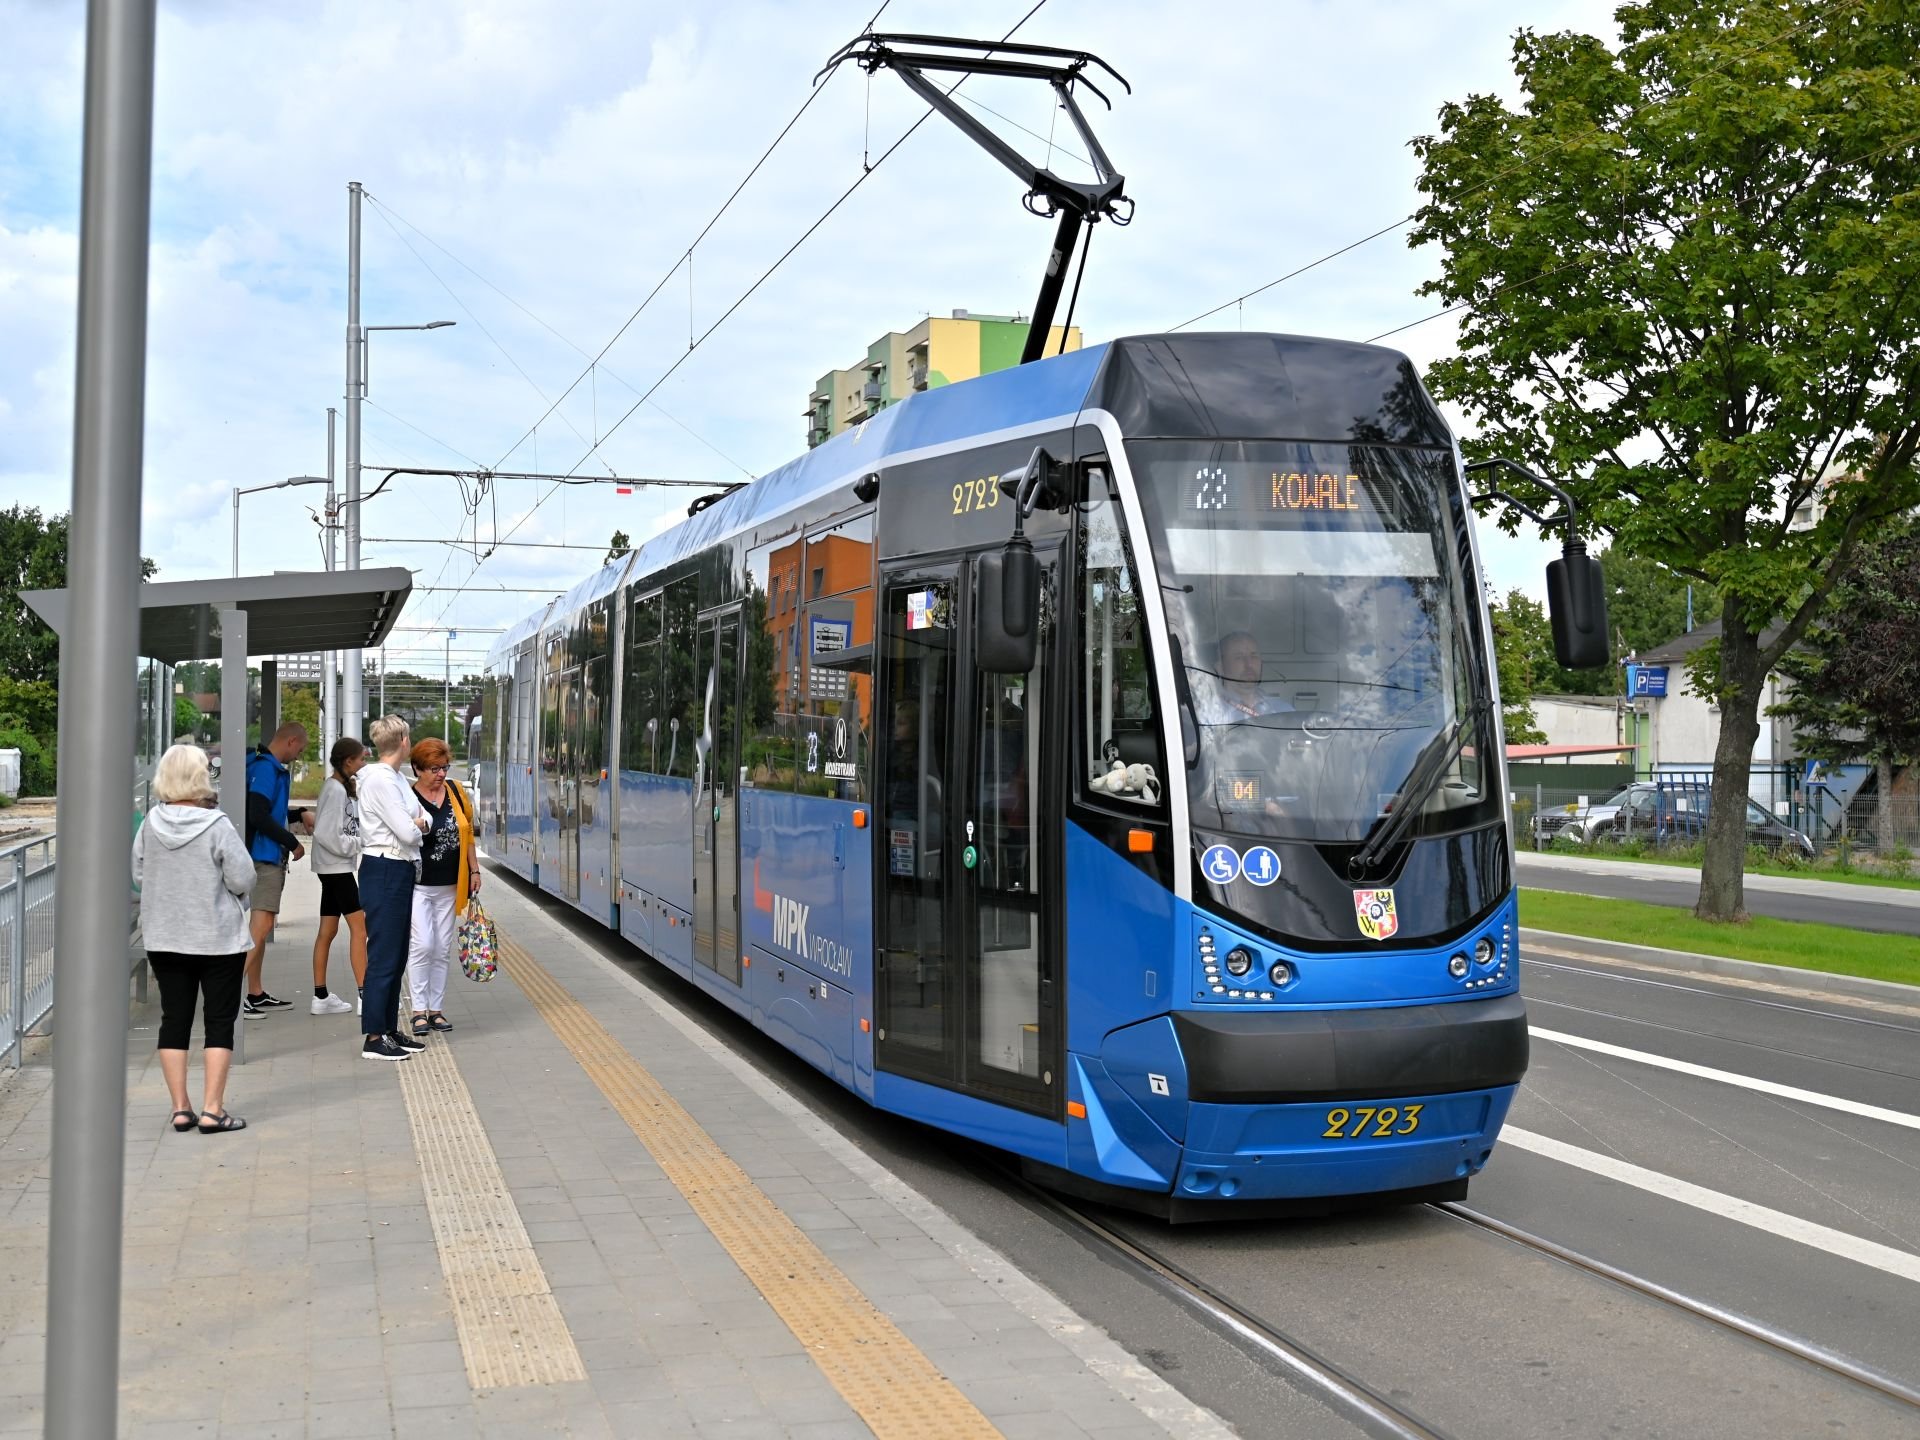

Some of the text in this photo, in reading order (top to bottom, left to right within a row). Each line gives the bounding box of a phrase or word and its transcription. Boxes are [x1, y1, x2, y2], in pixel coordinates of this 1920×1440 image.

[952, 475, 999, 515] 2723
[1272, 473, 1359, 509] KOWALE
[1637, 676, 1646, 688] P
[824, 761, 856, 777] MODERTRANS
[1234, 781, 1253, 799] 04
[773, 893, 853, 978] MPK WROCŁAW
[1360, 915, 1377, 934] W
[1321, 1104, 1424, 1138] 2723
